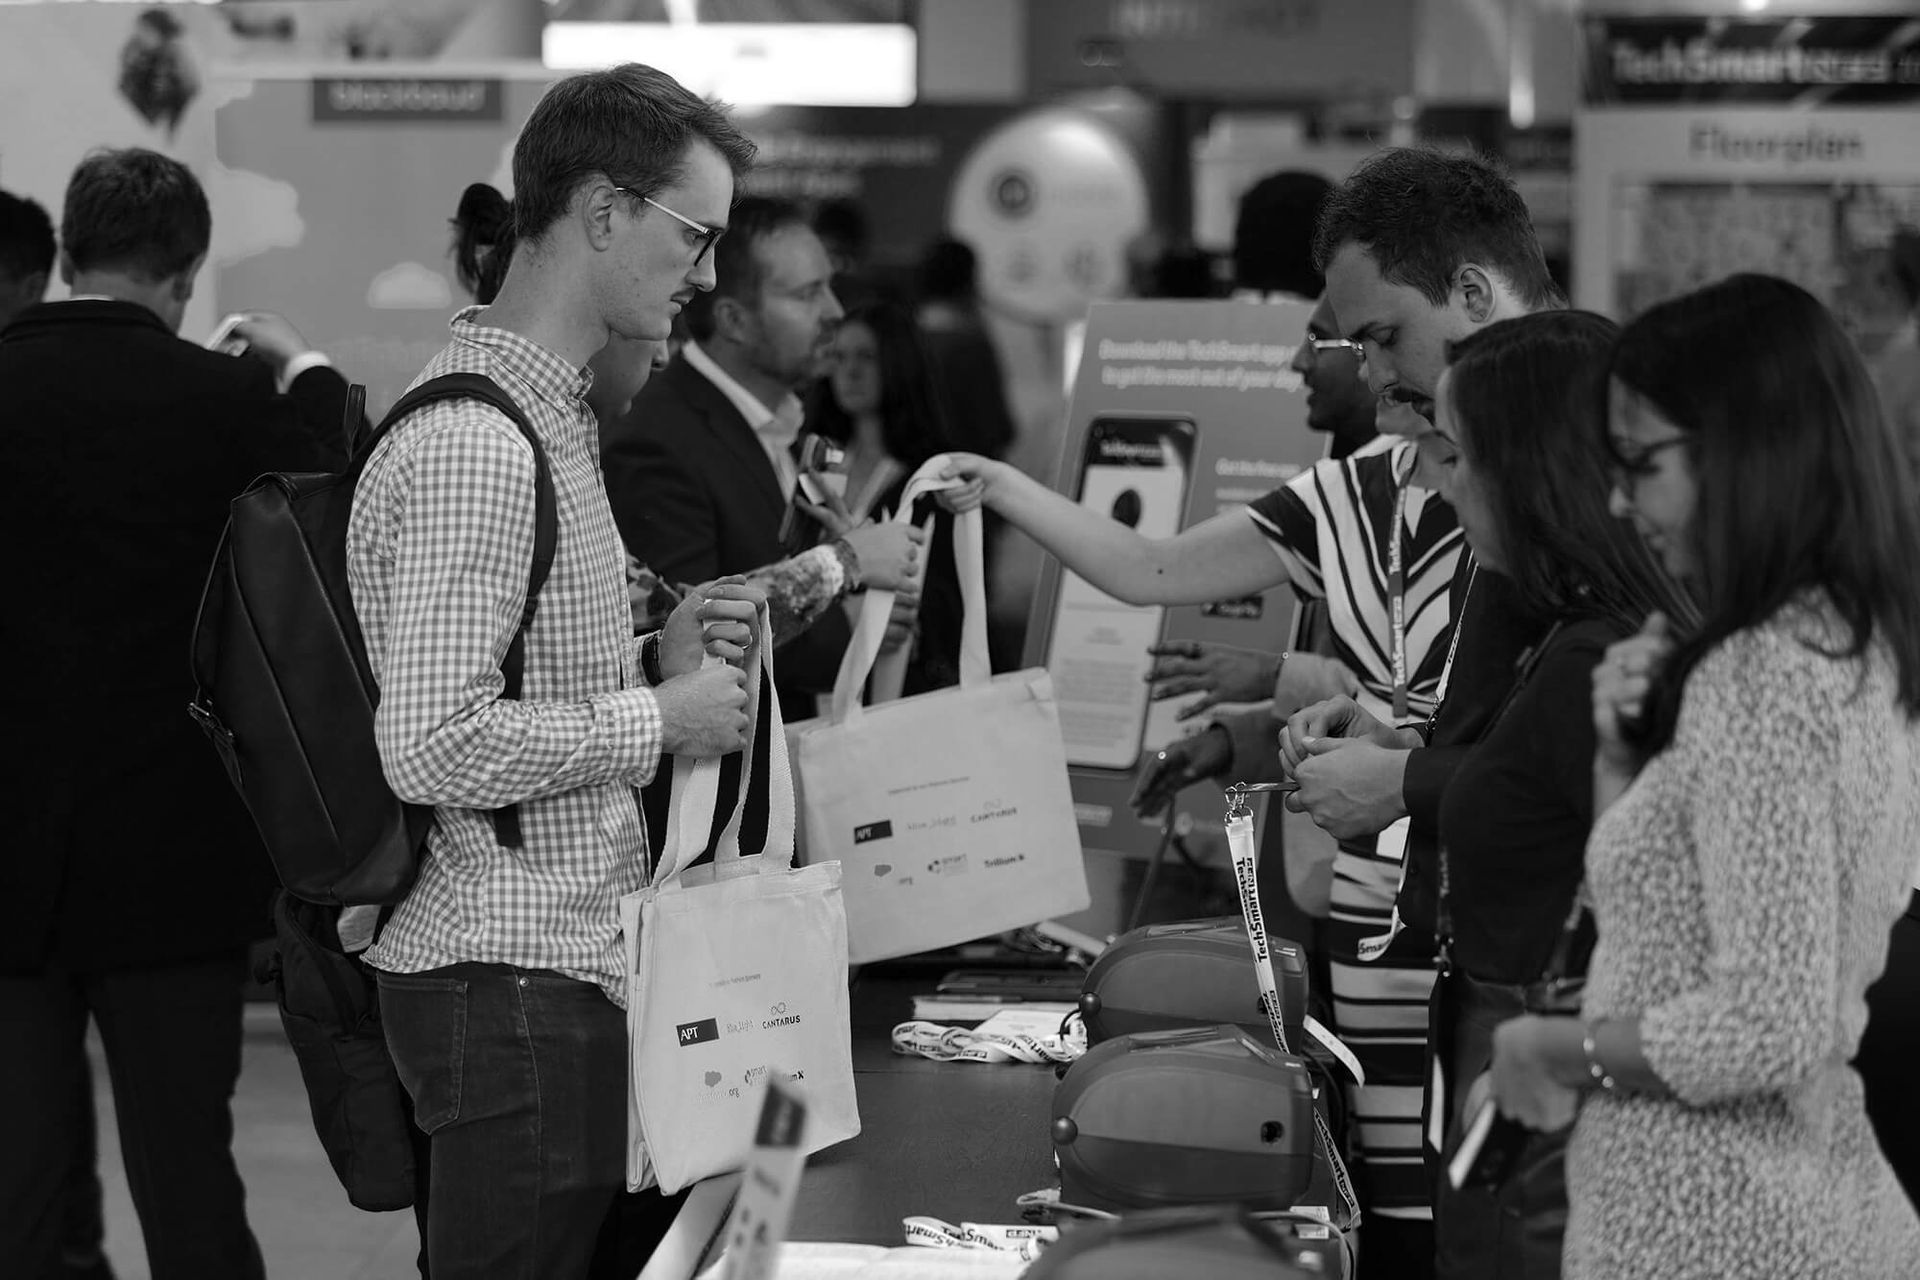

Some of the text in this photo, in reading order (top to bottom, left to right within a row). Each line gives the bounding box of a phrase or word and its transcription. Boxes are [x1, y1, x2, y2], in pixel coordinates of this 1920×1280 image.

[1688, 117, 1862, 168] Floorplan
[1247, 888, 1268, 963] TechSmart
[680, 1027, 698, 1041] APT
[762, 1015, 801, 1030] CANTARUS
[1315, 1111, 1345, 1181] TechSmart
